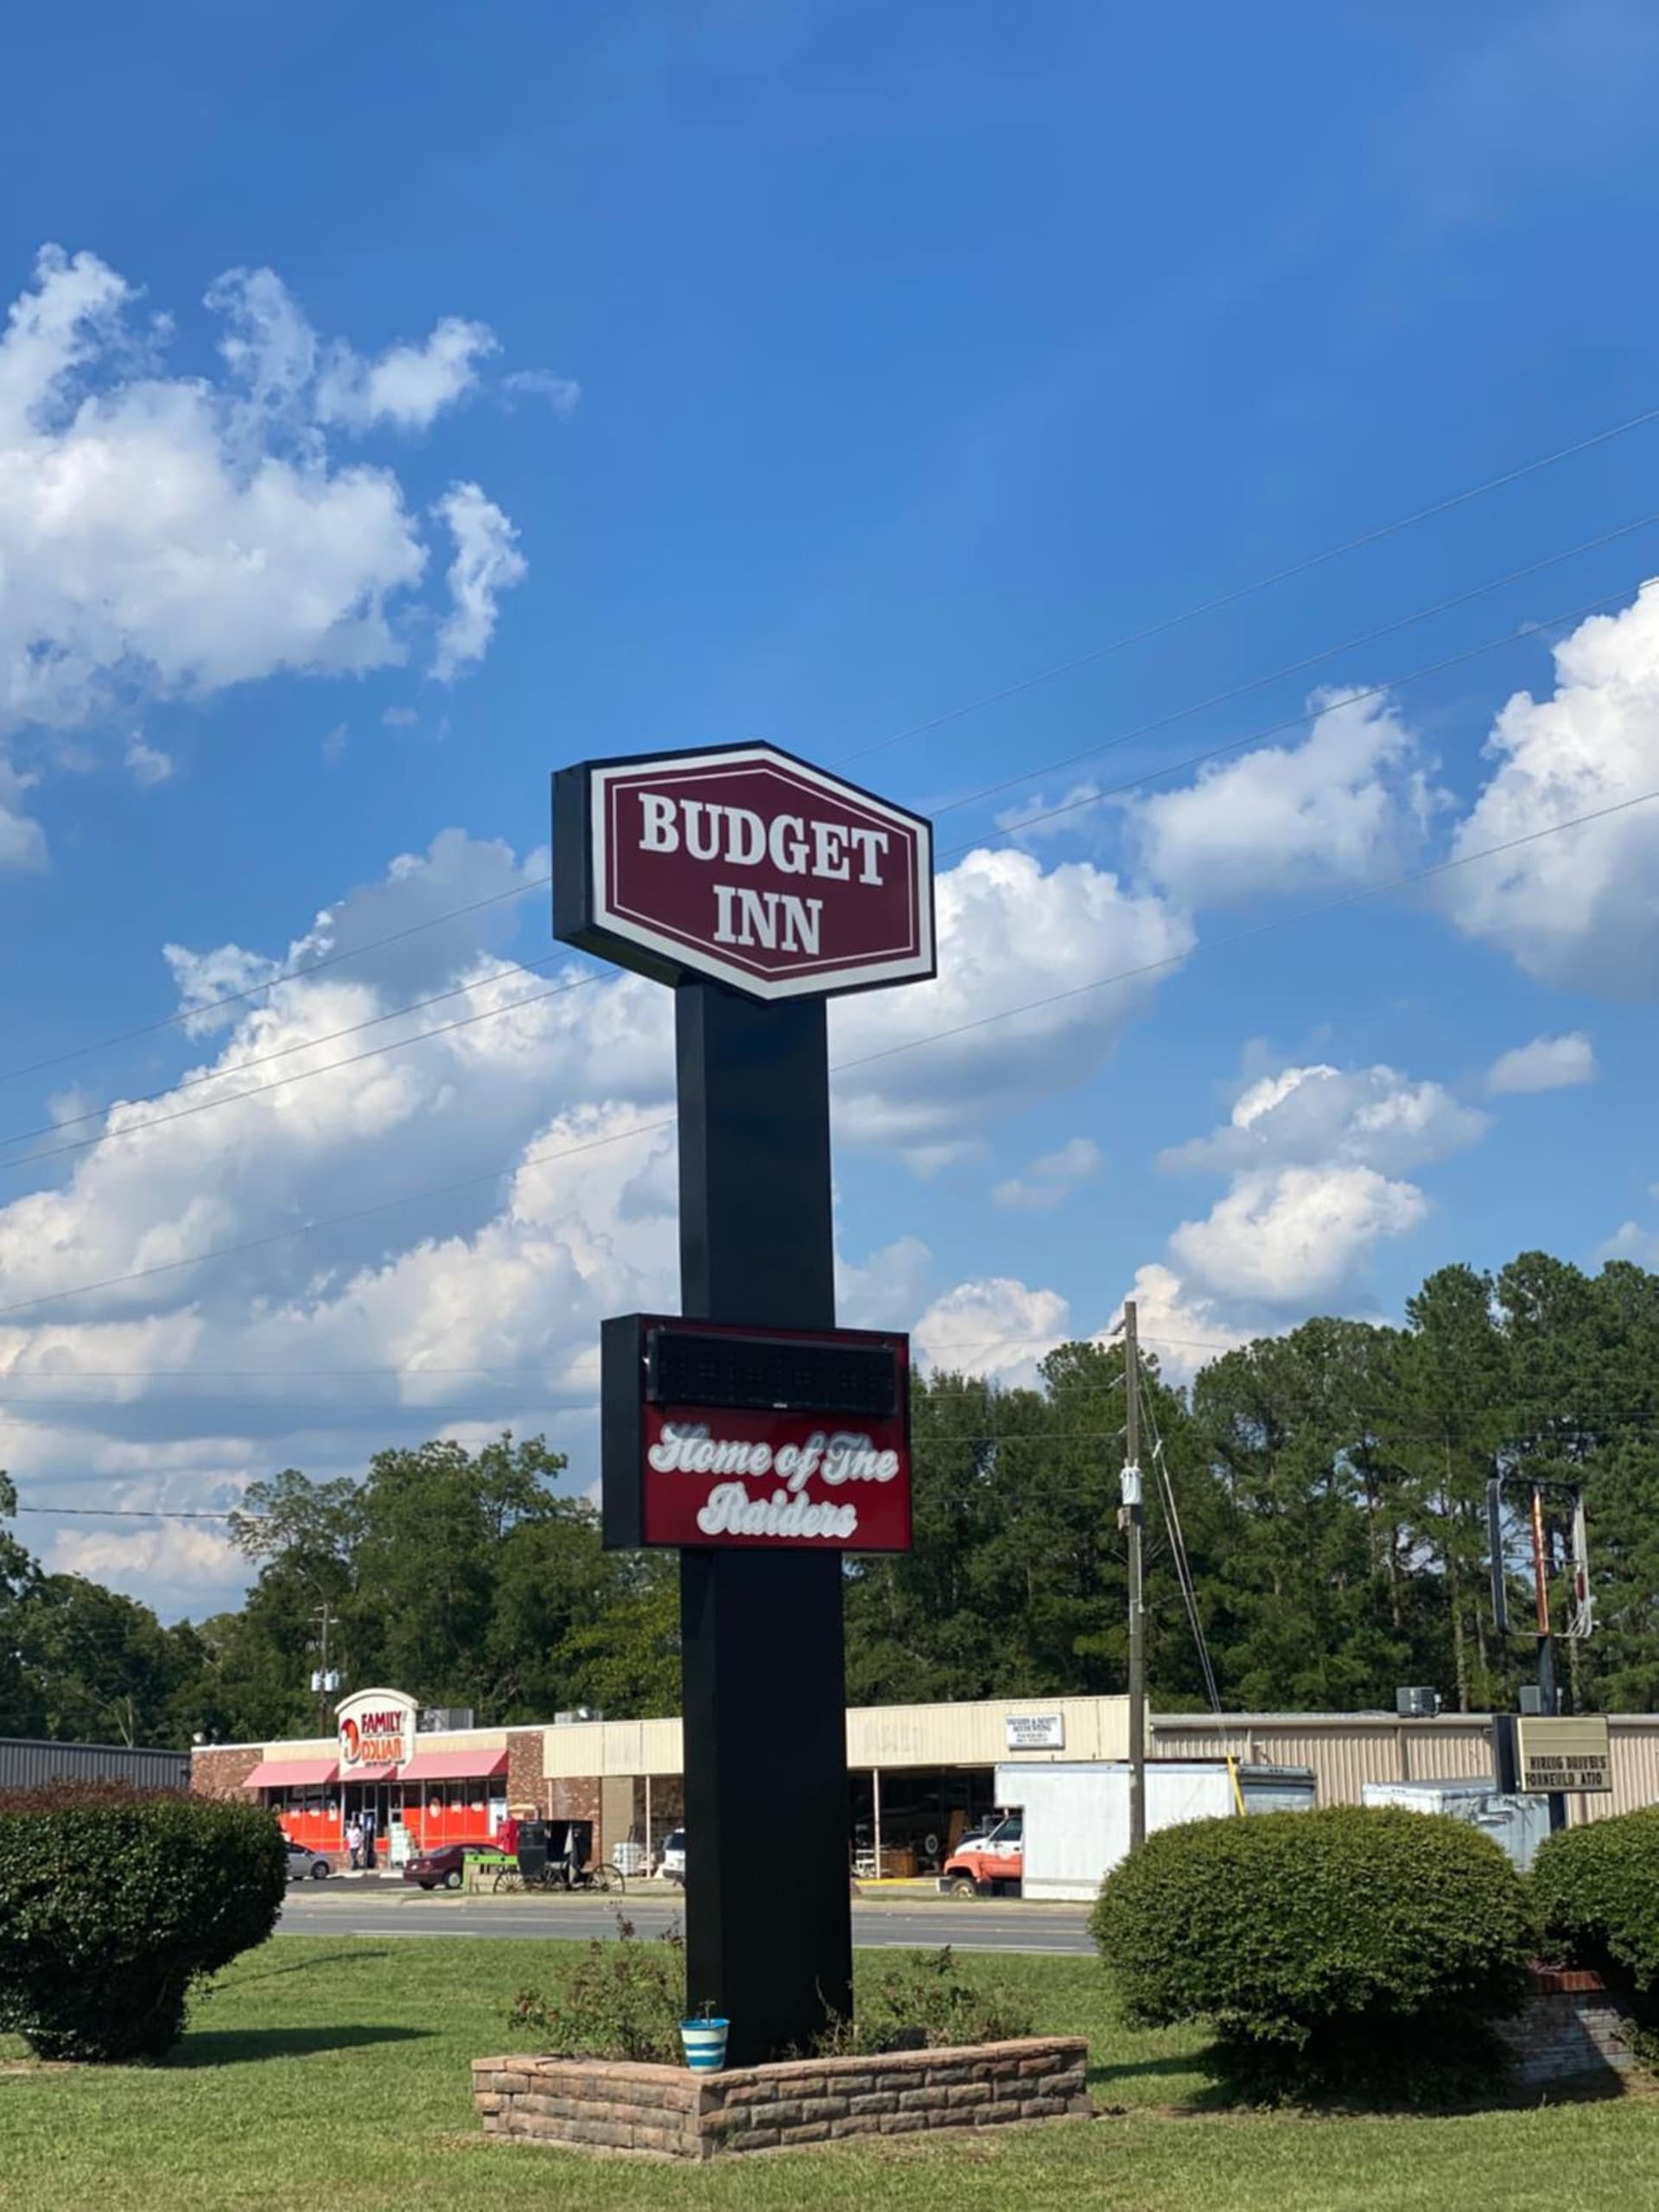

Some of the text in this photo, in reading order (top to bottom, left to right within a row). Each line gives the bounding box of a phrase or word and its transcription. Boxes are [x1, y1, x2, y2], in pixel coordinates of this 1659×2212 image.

[638, 792, 889, 887] BUDGET
[713, 885, 823, 955] INN
[648, 1422, 899, 1491] Home of The
[696, 1481, 858, 1539] Raiders
[361, 1711, 402, 1734] FAMILY
[361, 1737, 402, 1761] DOLLAR
